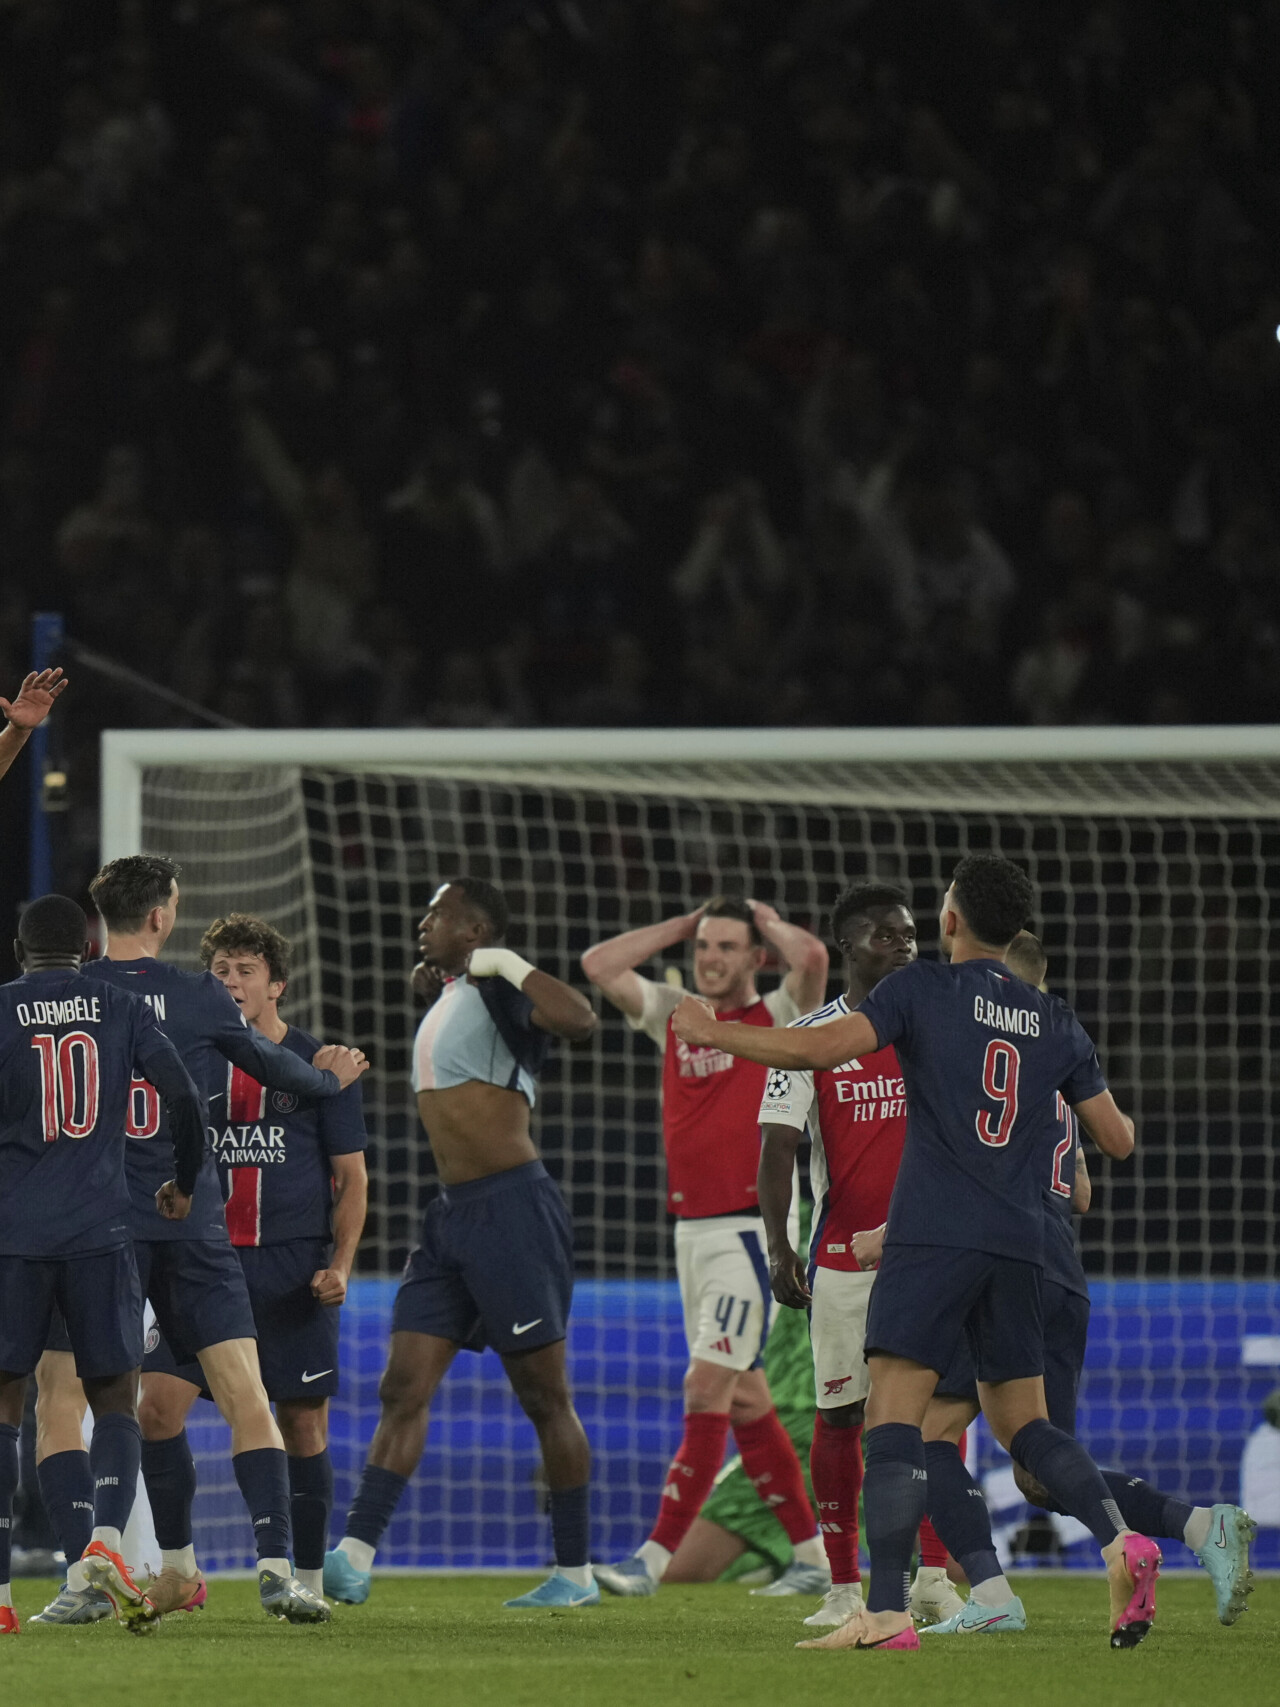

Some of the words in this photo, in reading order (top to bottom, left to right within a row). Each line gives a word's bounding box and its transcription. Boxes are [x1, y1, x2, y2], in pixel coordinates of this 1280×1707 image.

[974, 995, 1040, 1037] G.RAMOS
[31, 1030, 100, 1142] 10
[975, 1038, 1021, 1148] 9
[853, 1102, 877, 1123] FLY
[207, 1126, 287, 1153] QATAR
[219, 1149, 287, 1164] AIRWAYS
[1049, 1089, 1071, 1198] 2
[714, 1294, 752, 1337] 41
[95, 1475, 120, 1489] PARIS
